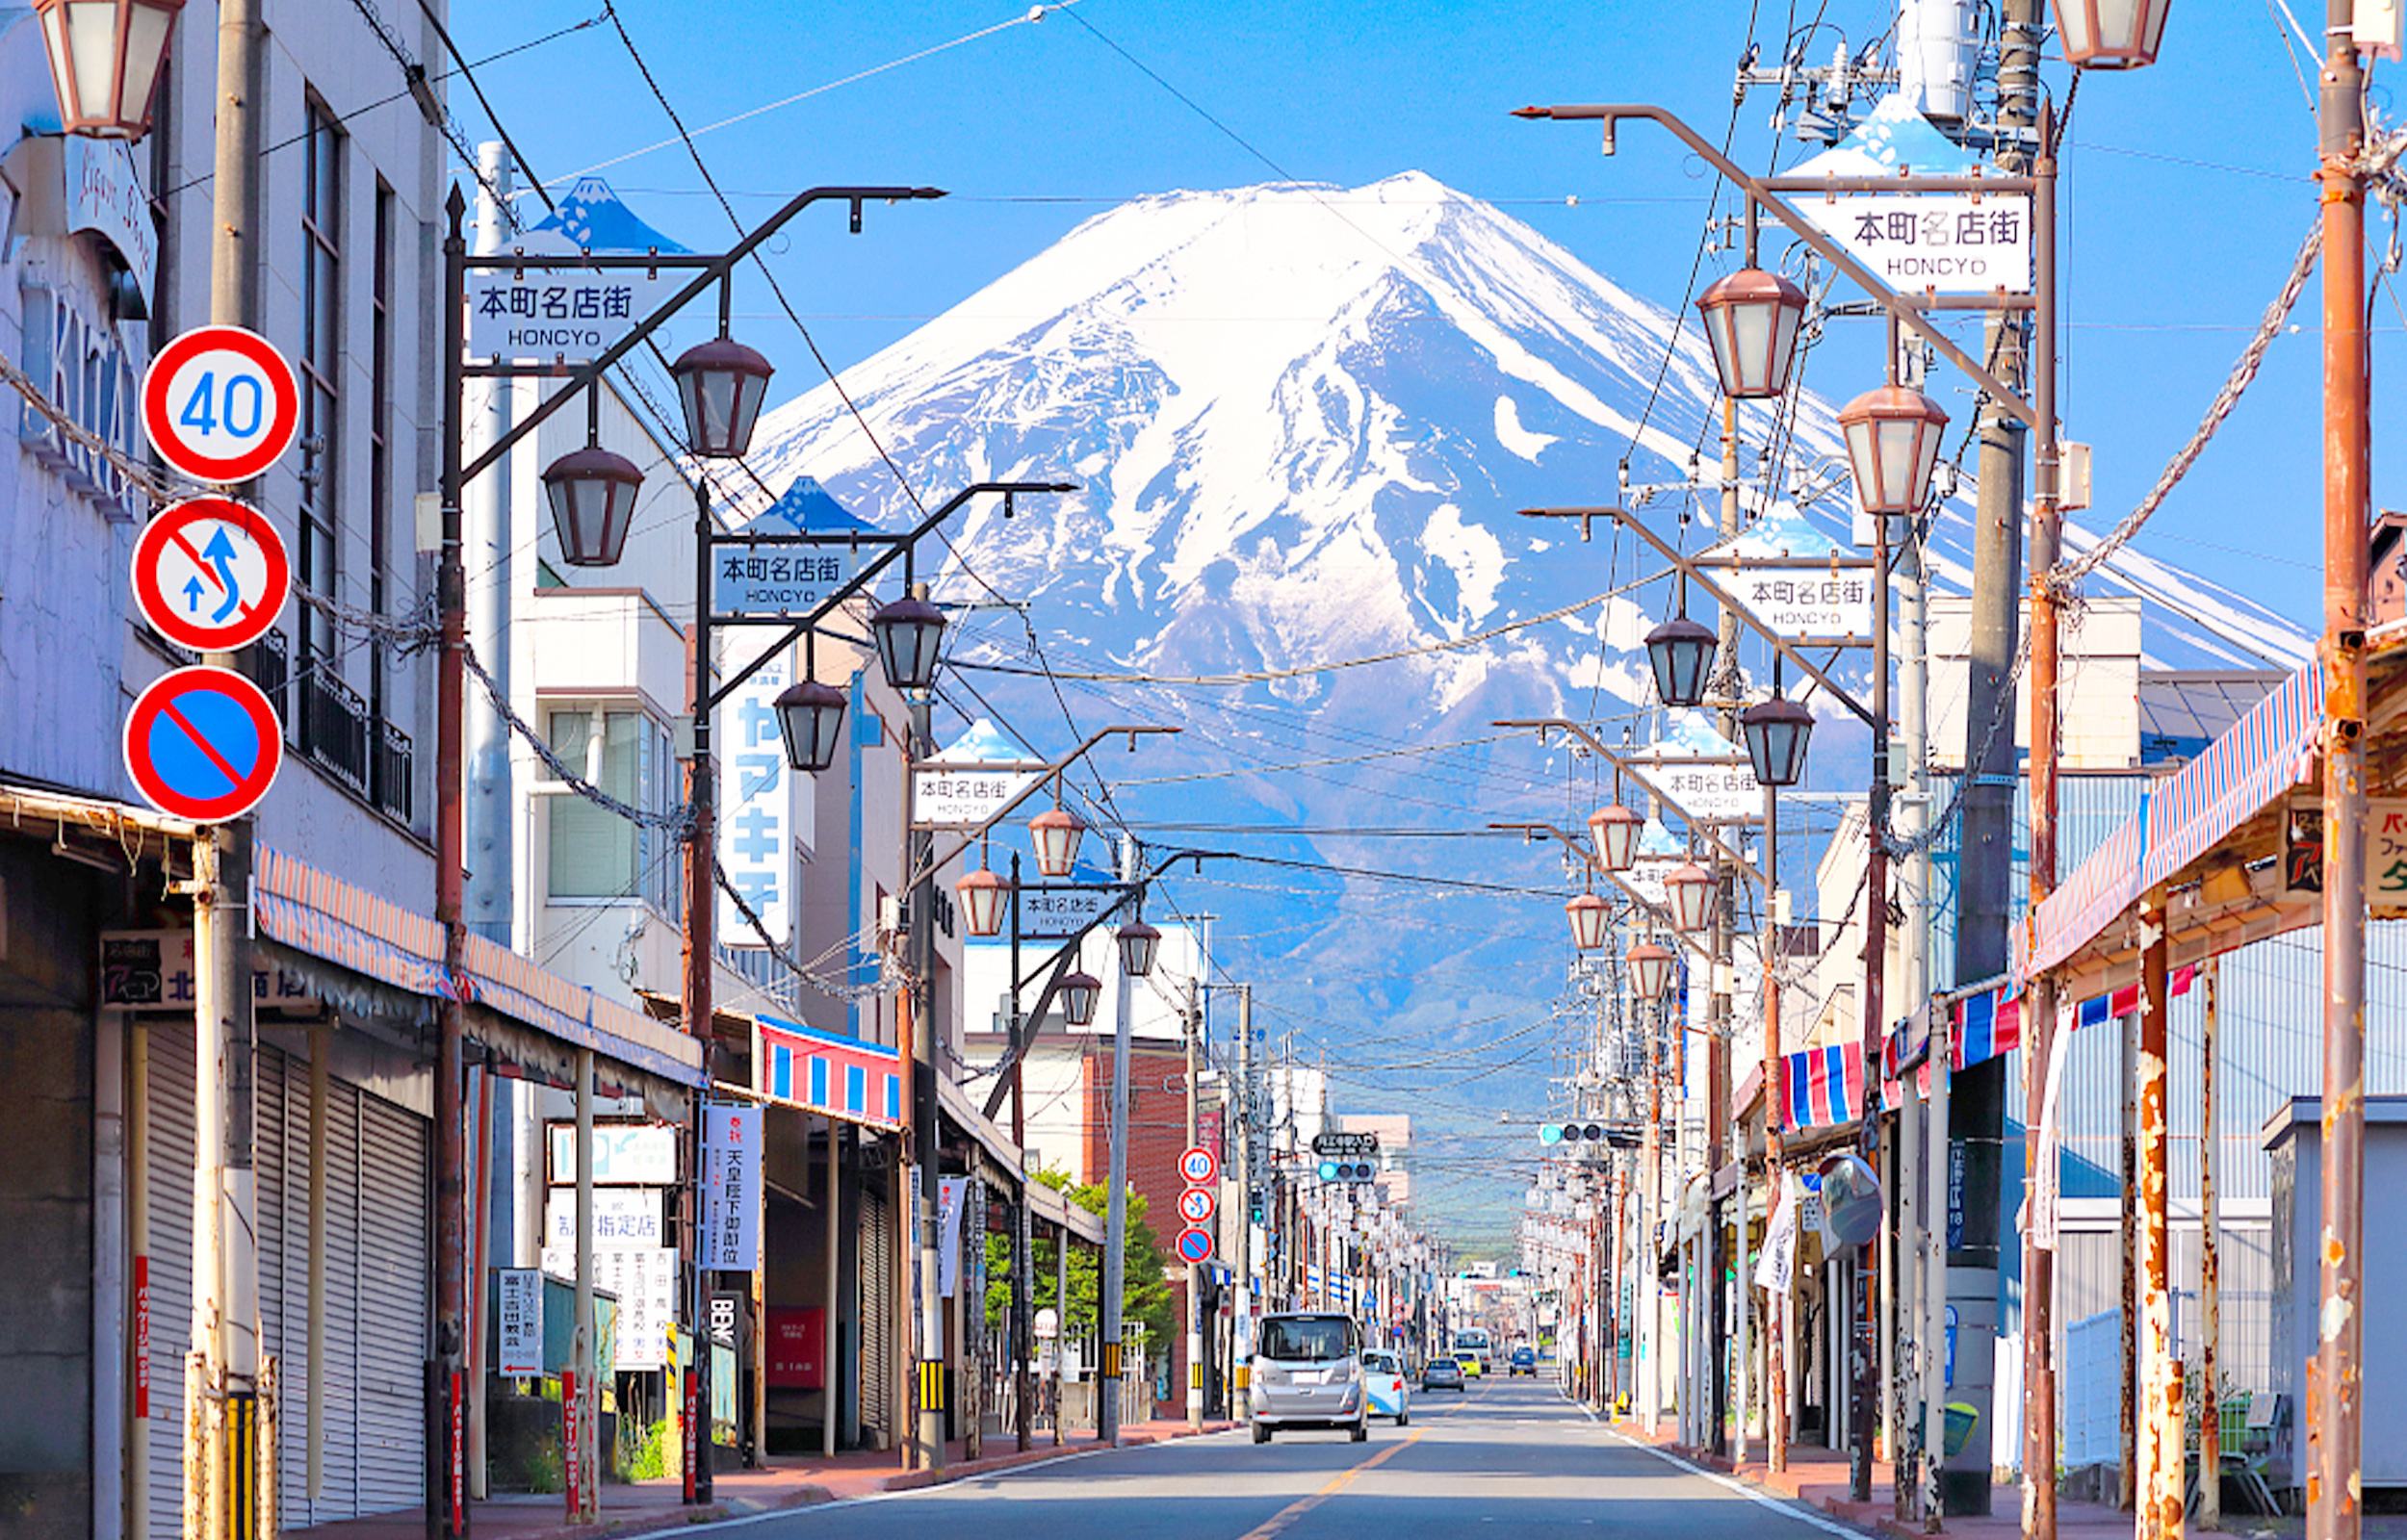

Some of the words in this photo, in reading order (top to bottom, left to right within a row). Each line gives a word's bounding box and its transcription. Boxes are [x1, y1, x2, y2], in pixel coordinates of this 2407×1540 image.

[1854, 210, 2019, 246] 本町名店街
[479, 286, 632, 320] 本町名店街
[180, 371, 263, 438] 40
[723, 556, 840, 582] 本町名店街
[1752, 579, 1863, 604] 本町名店街
[921, 780, 1006, 799] 本町名店街
[1669, 773, 1755, 793] 本町名店街
[2382, 813, 2407, 834] バ
[1027, 897, 1099, 913] 本町名店街
[1188, 1157, 1207, 1174] 40
